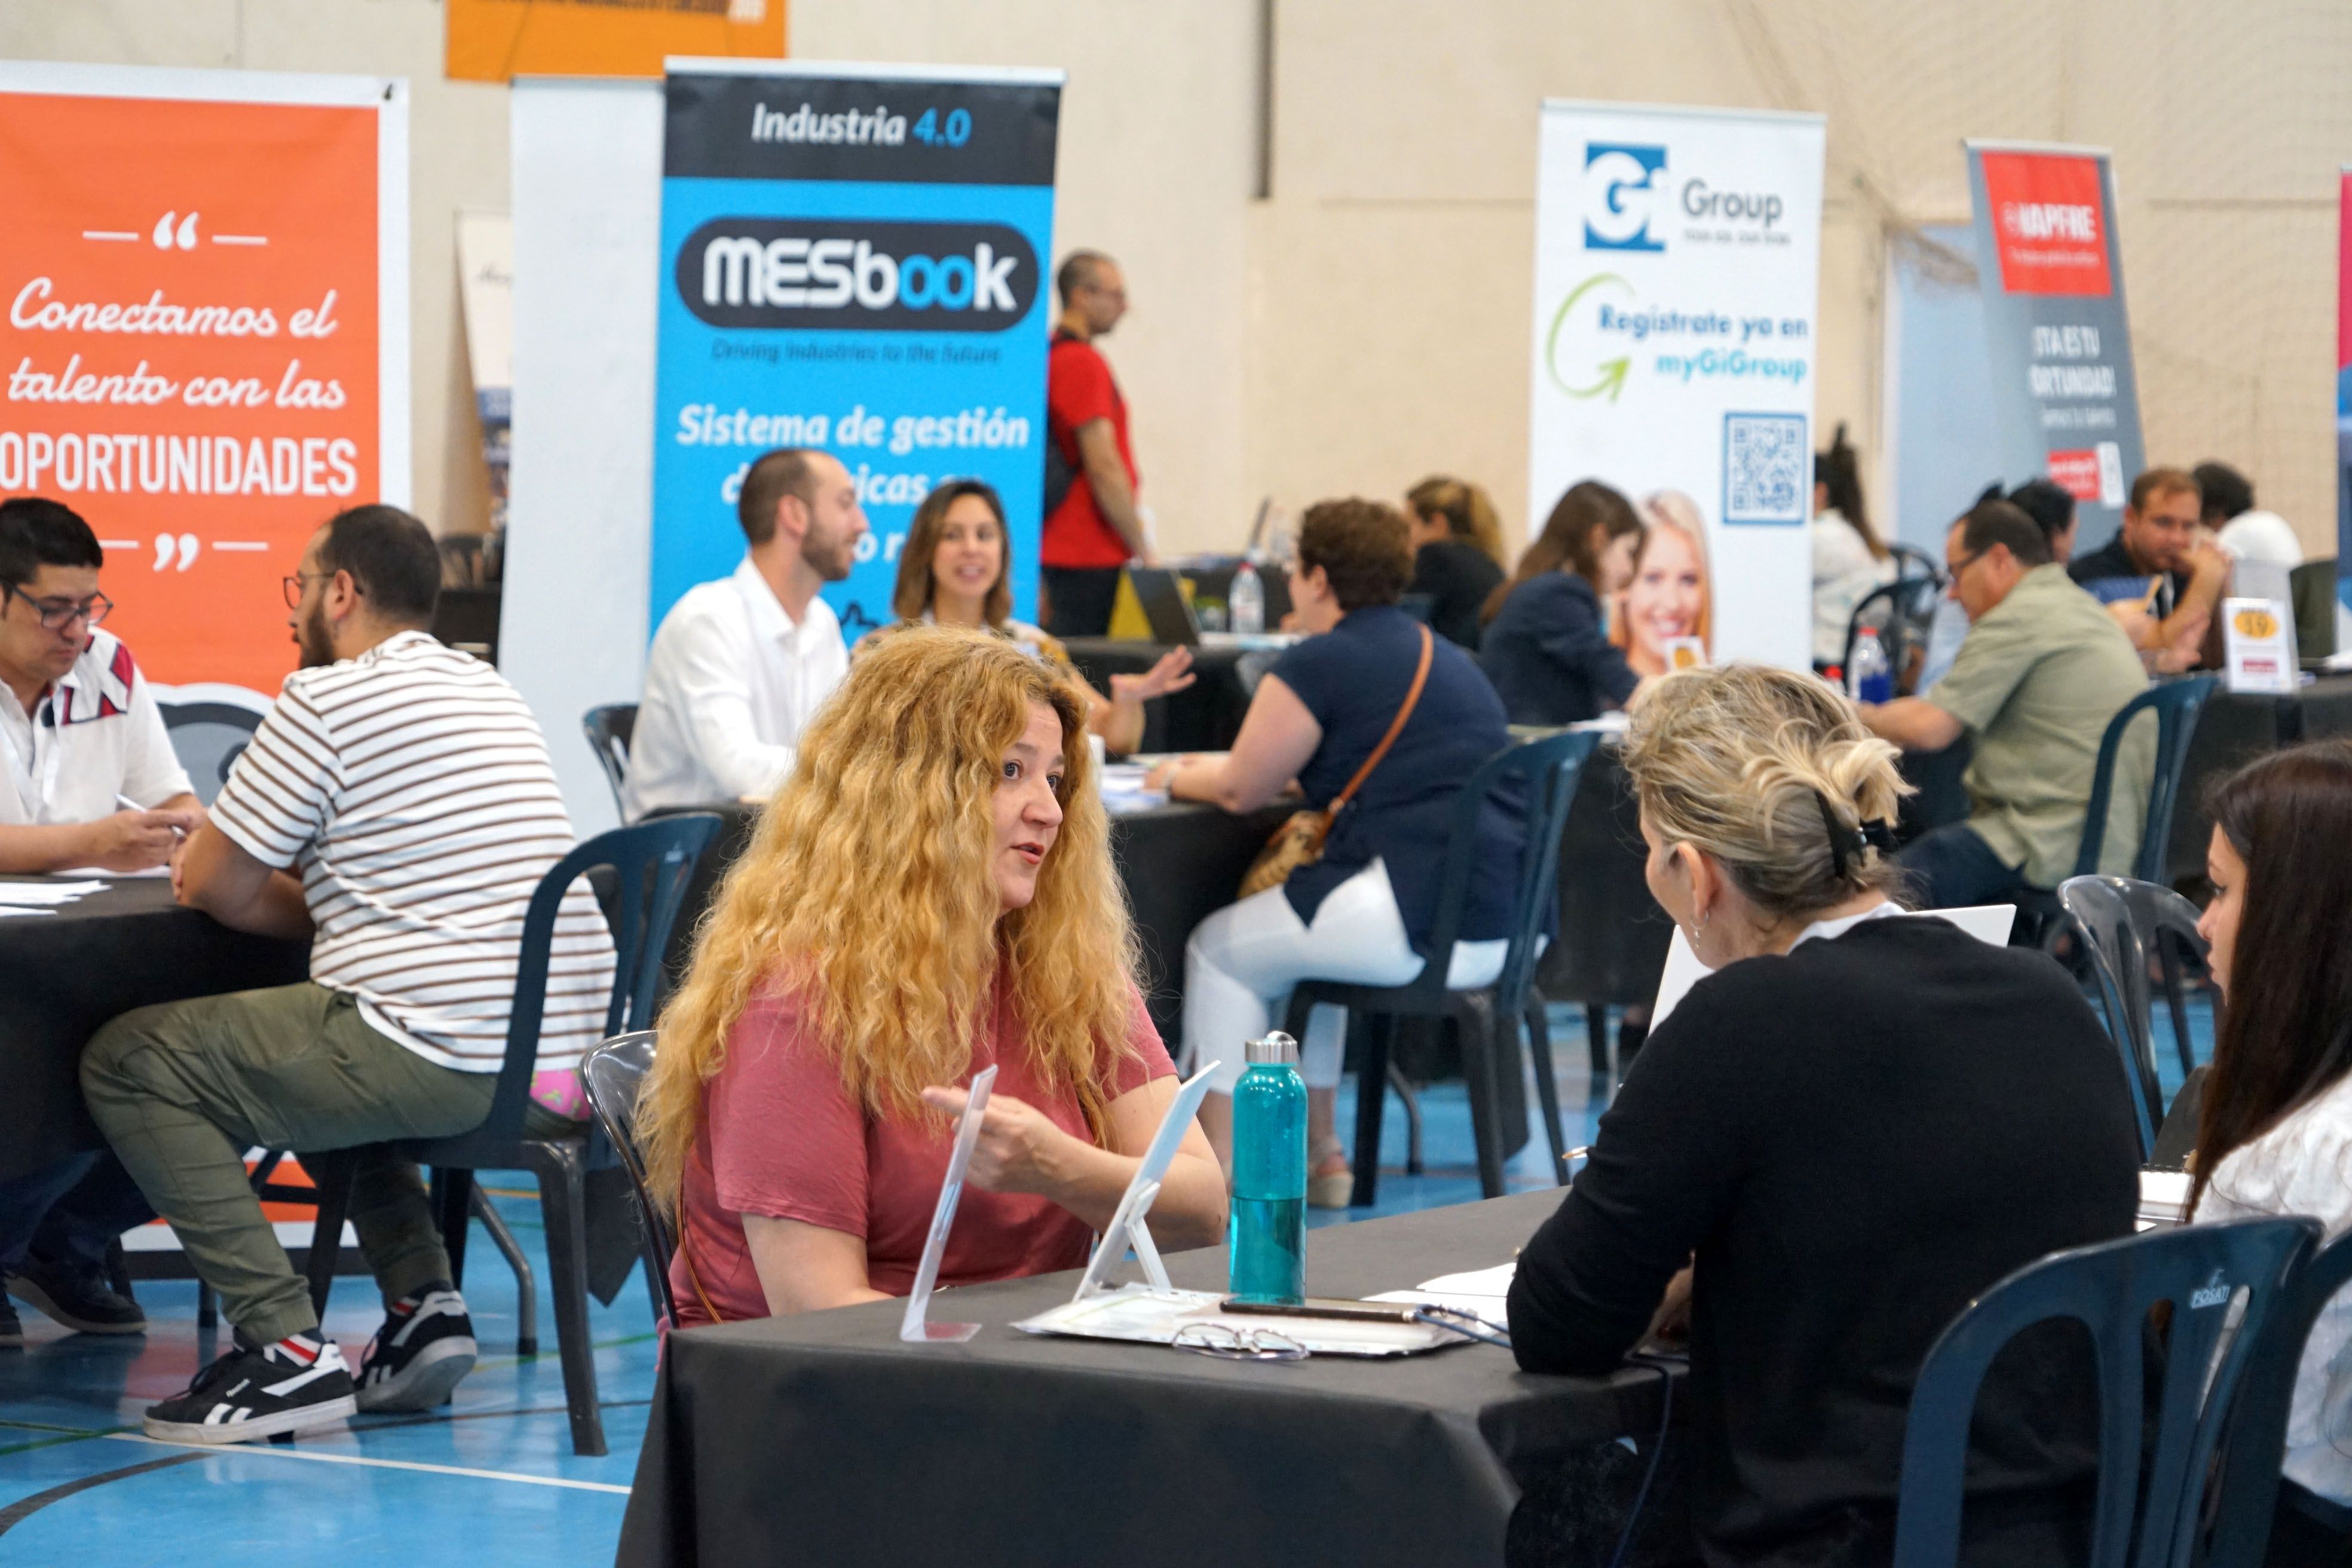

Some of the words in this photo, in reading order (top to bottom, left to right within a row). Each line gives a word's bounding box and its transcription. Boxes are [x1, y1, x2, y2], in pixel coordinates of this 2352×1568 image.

[751, 103, 906, 145] Industria
[912, 108, 972, 147] 4.0
[1682, 178, 1783, 228] Group
[10, 277, 278, 337] Conectamos
[288, 289, 338, 338] el
[1740, 313, 1774, 342] ya
[1780, 316, 1806, 336] en
[8, 354, 178, 405] talento
[182, 376, 270, 408] con
[274, 359, 347, 409] las
[1655, 348, 1807, 383] myGiGroup
[676, 404, 829, 446] Sistema
[836, 405, 883, 446] de
[889, 406, 1029, 455] gestión
[0, 431, 358, 496] OPORTUNIDADES
